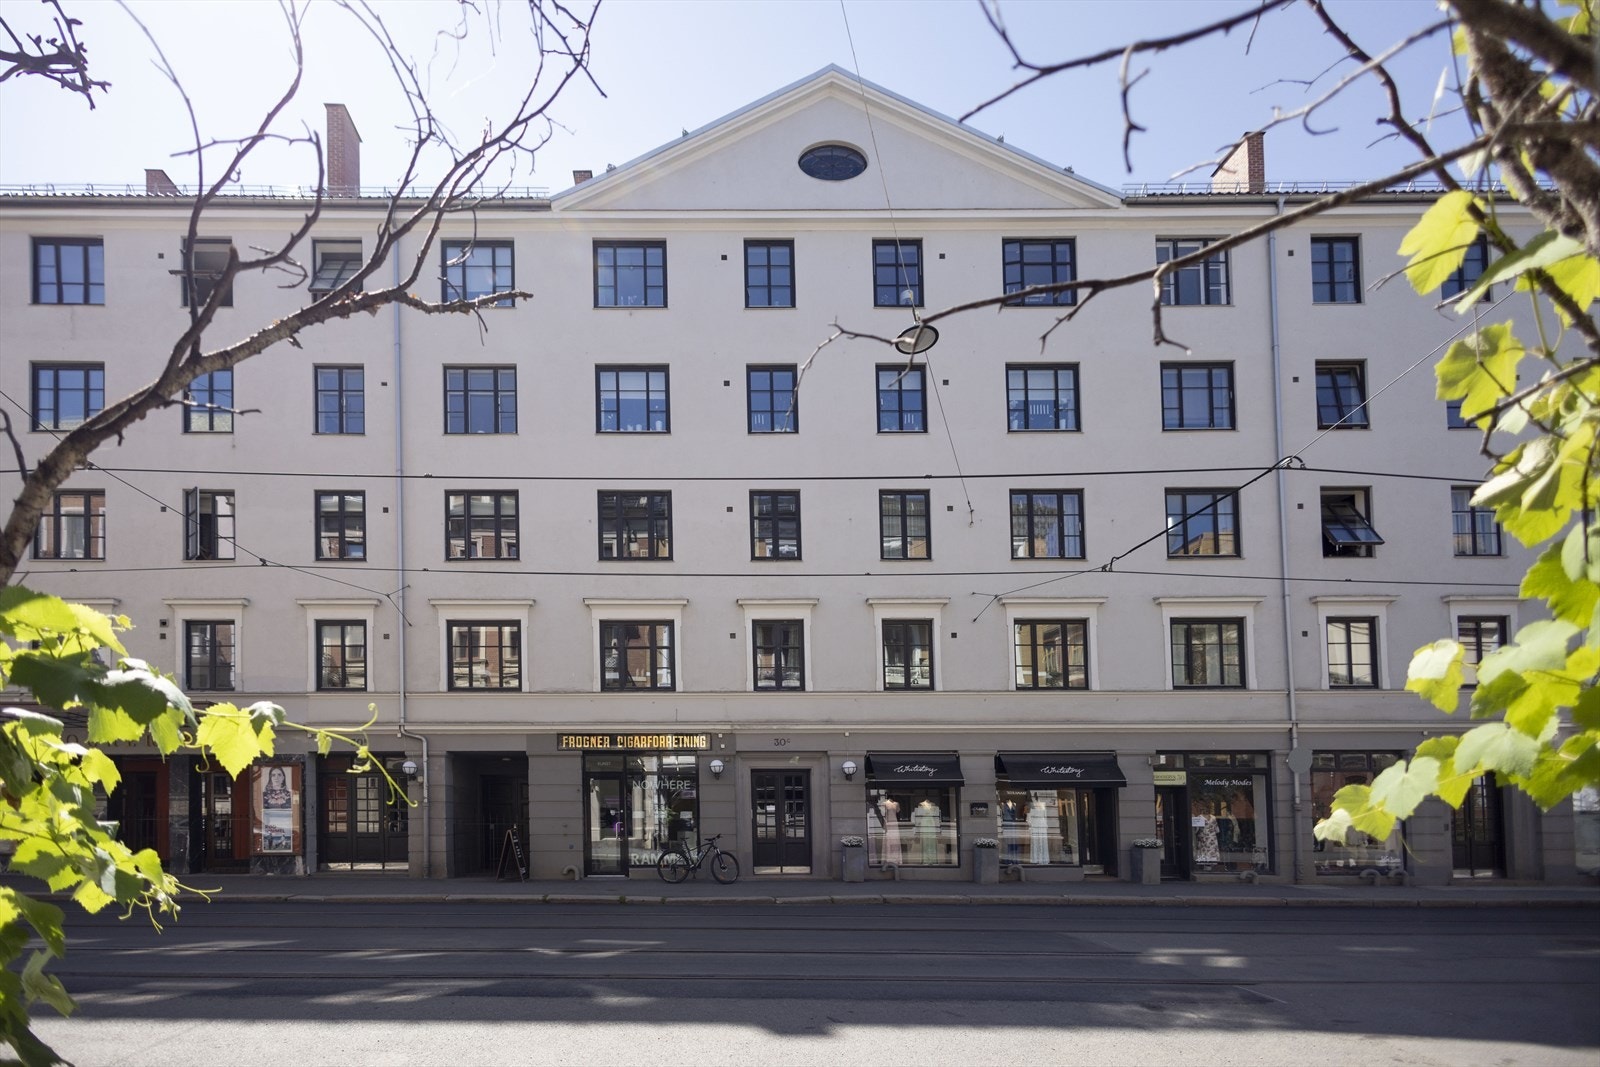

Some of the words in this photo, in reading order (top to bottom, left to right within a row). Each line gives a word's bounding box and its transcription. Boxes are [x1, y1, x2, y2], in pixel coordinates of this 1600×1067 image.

[562, 735, 610, 748] FROGNER
[617, 735, 706, 748] CIGARFORRETNING
[632, 780, 691, 790] NOWHERE
[1204, 778, 1229, 788] Melody
[1230, 778, 1252, 786] Modes
